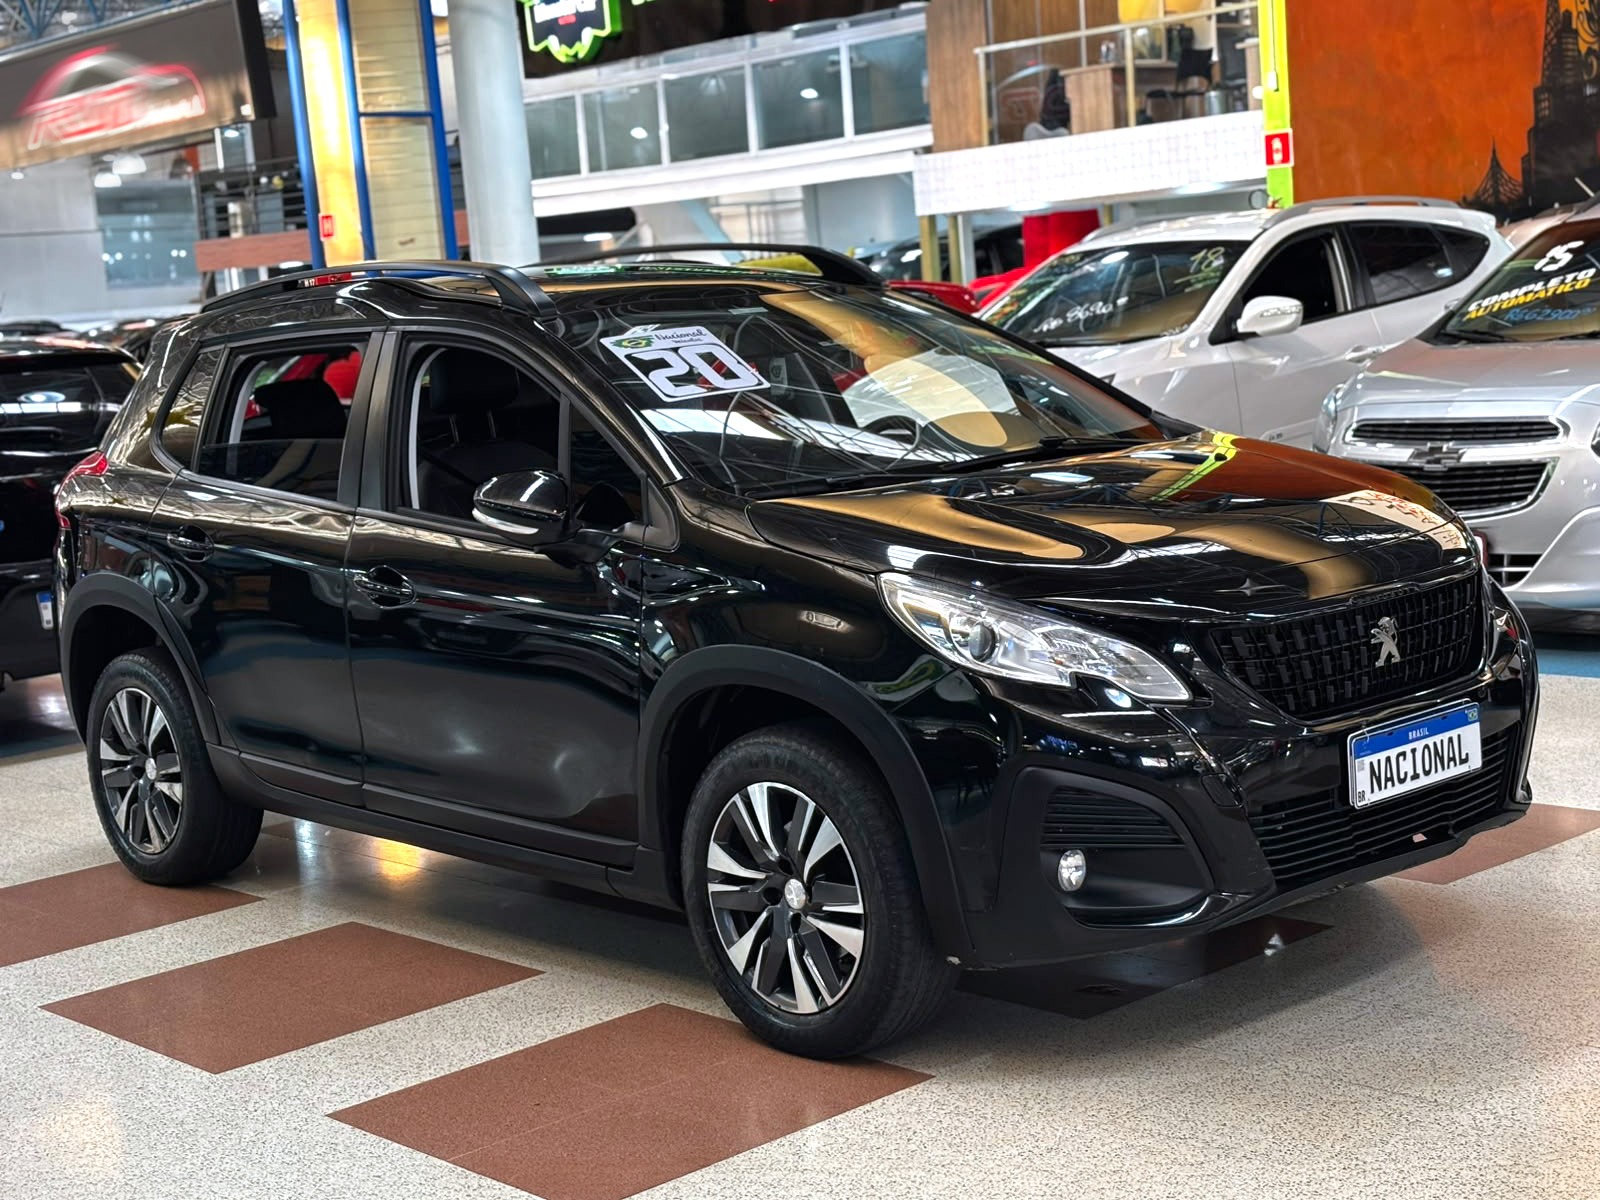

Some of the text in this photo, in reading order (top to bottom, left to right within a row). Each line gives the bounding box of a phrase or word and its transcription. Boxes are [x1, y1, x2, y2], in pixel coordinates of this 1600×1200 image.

[1462, 278, 1592, 321] AUTOMATICO
[1467, 267, 1597, 312] COMPLETO
[655, 328, 708, 342] Nacional
[625, 343, 763, 398] 20
[1408, 727, 1429, 740] BRASIL
[1369, 733, 1469, 794] NACIONAL
[1357, 789, 1366, 803] BR
